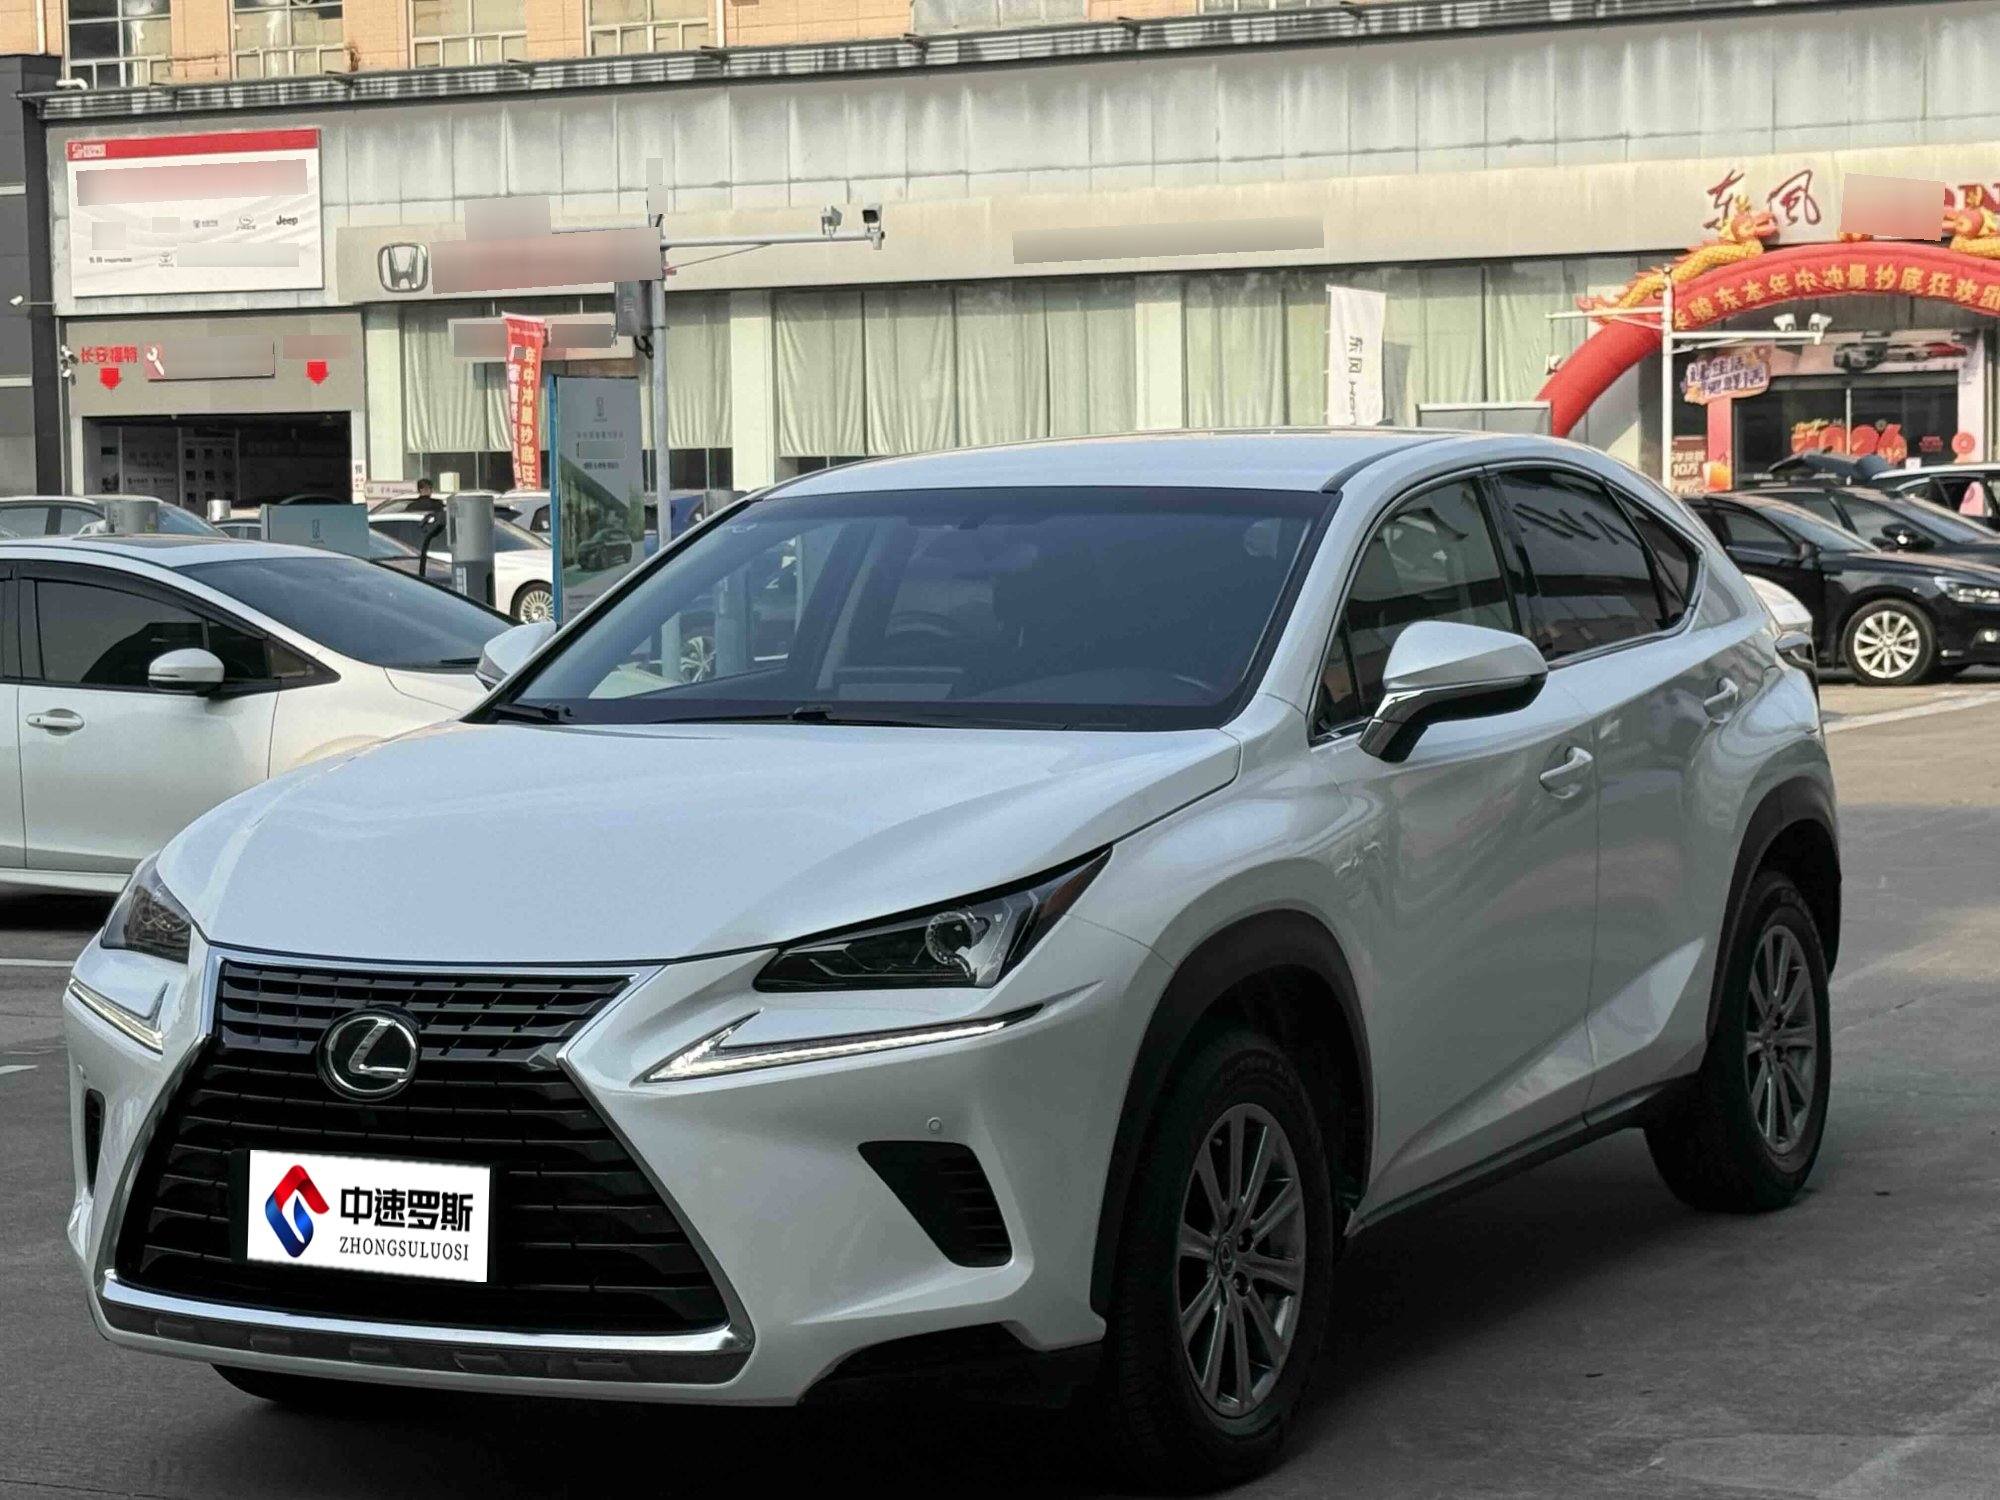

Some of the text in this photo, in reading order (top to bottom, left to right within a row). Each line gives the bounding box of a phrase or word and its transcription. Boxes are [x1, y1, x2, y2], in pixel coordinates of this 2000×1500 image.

[276, 214, 298, 226] Jeep
[81, 346, 138, 365] 长安福特
